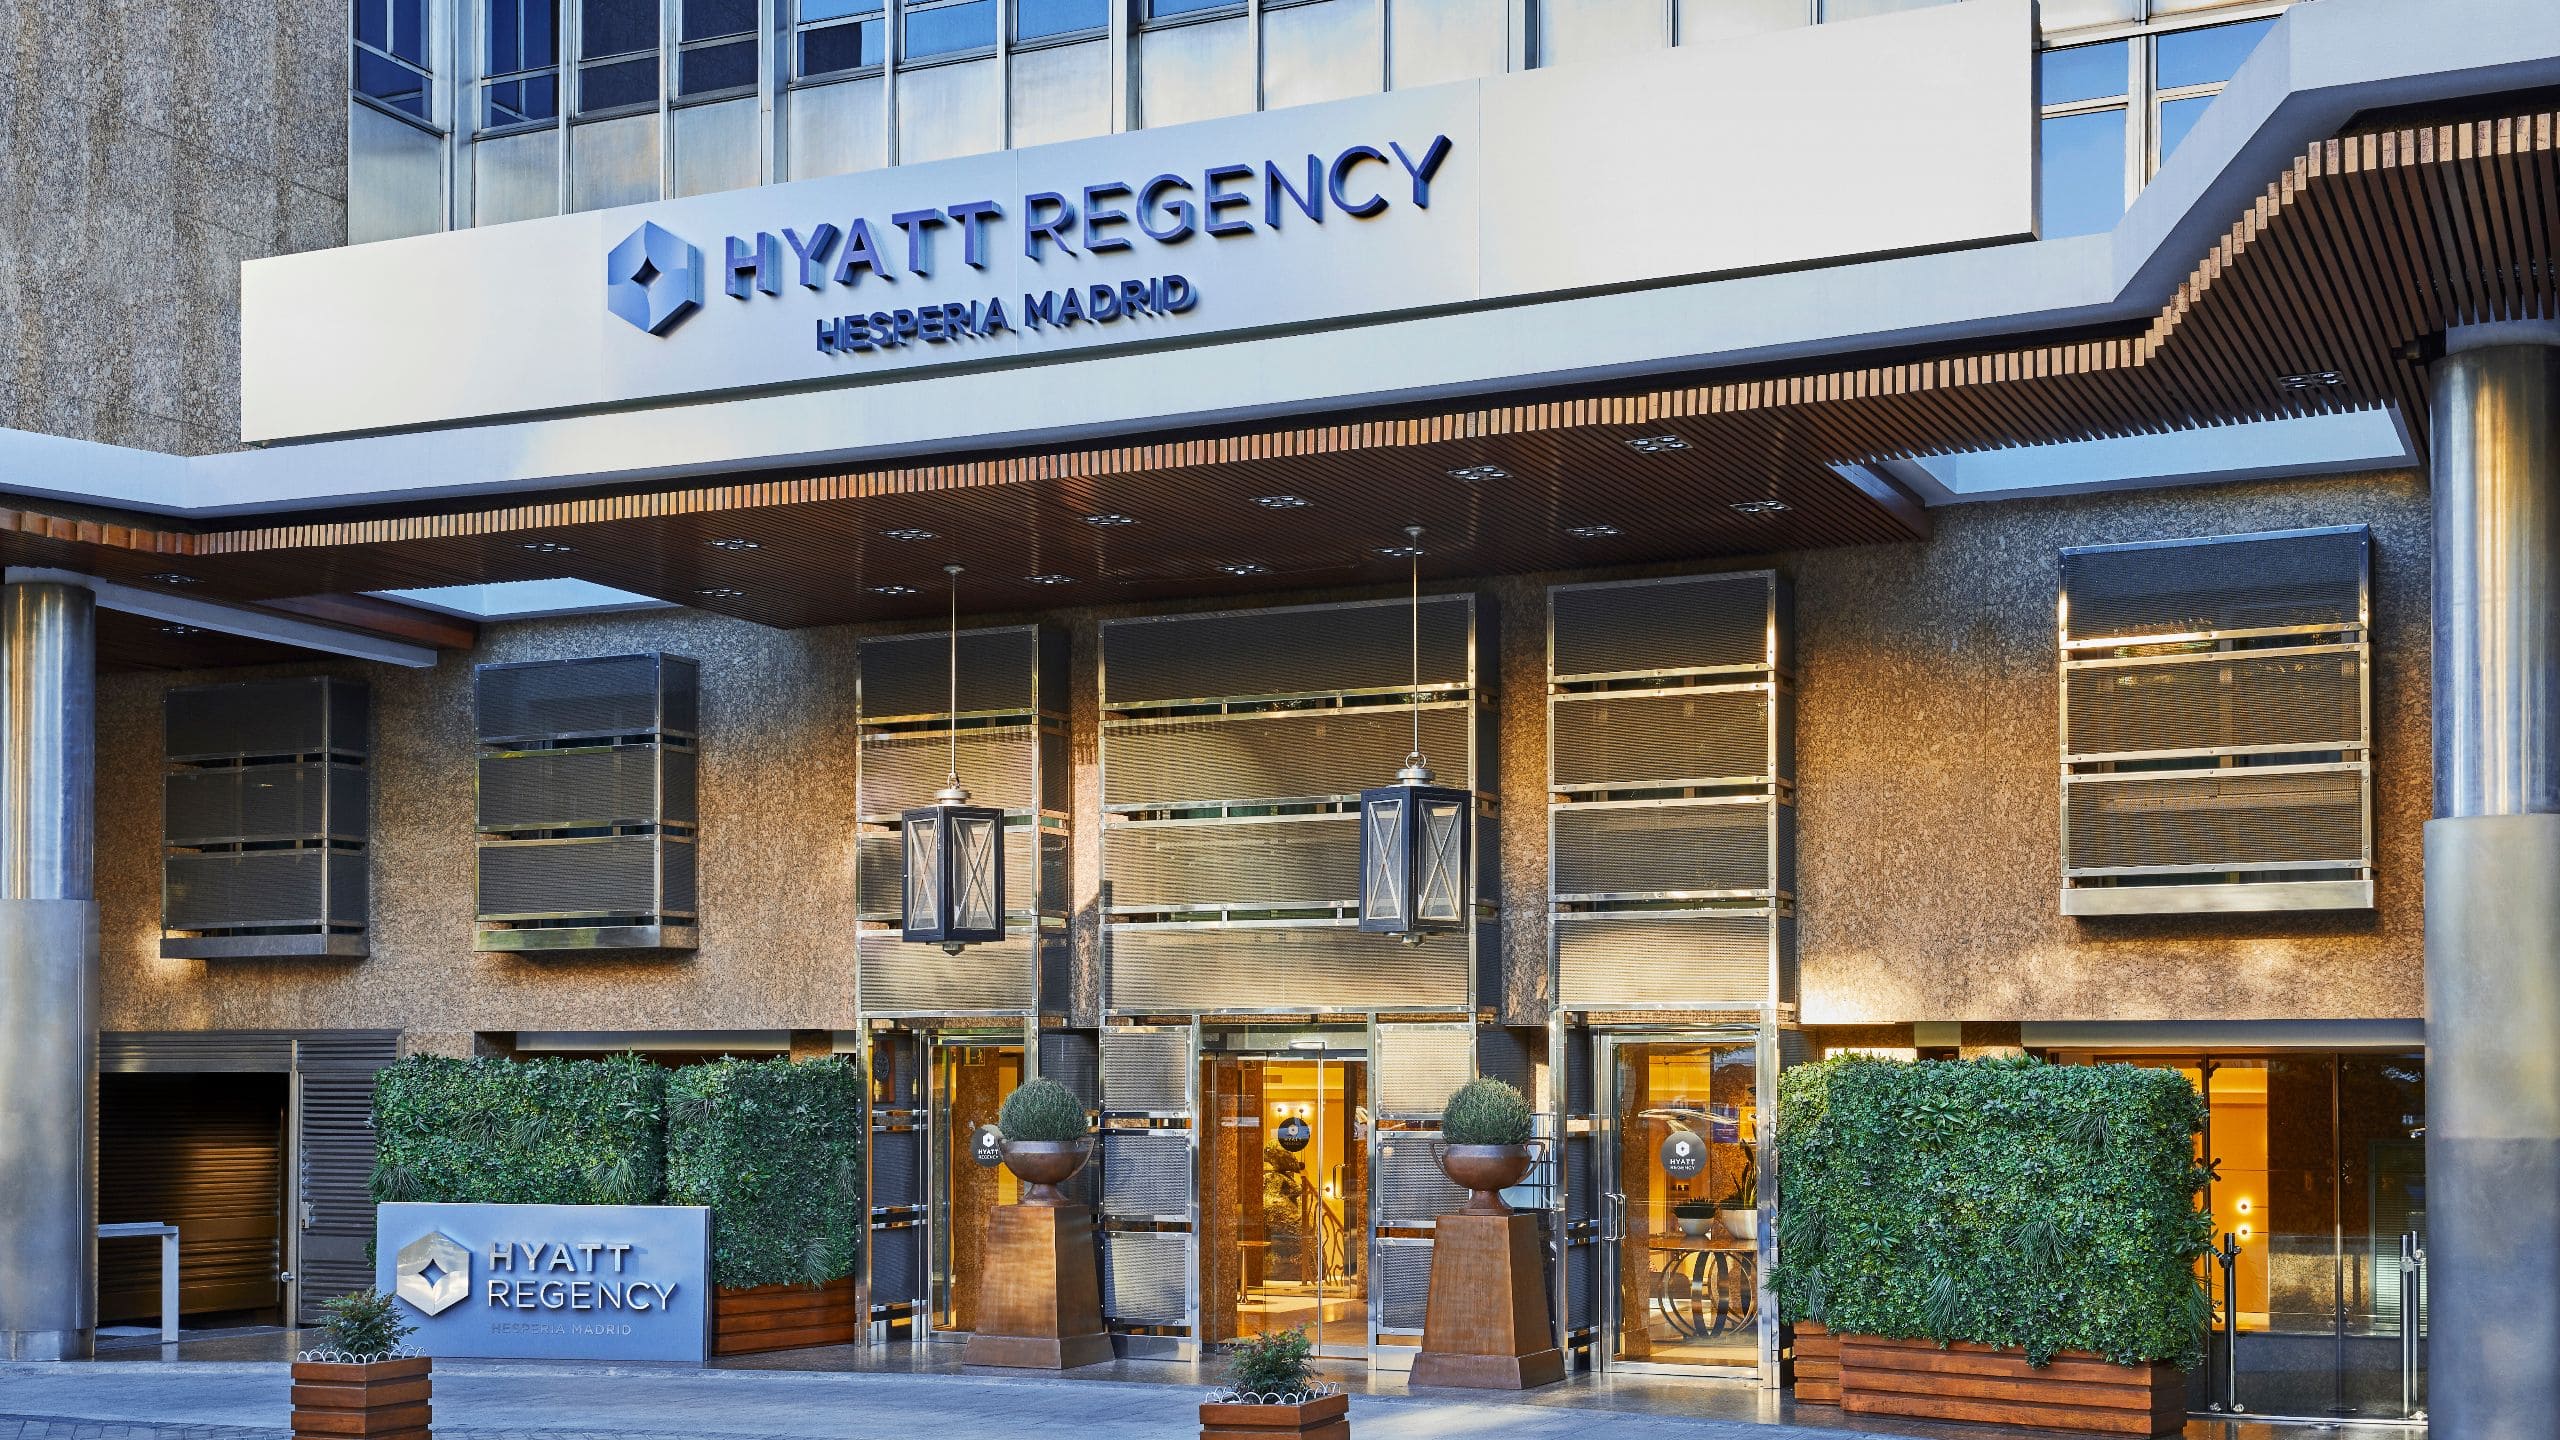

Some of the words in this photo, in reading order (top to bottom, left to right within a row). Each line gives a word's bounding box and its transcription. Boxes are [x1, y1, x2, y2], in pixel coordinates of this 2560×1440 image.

[725, 200, 1002, 300] HYATT
[1024, 134, 1453, 261] REGENCY
[816, 297, 1011, 353] HESPERIA
[1024, 273, 1198, 328] MADRID
[489, 1242, 630, 1272] HYATT
[488, 1279, 678, 1311] REGENCY
[491, 1322, 565, 1335] HESPERIA
[572, 1323, 632, 1336] MADRID
